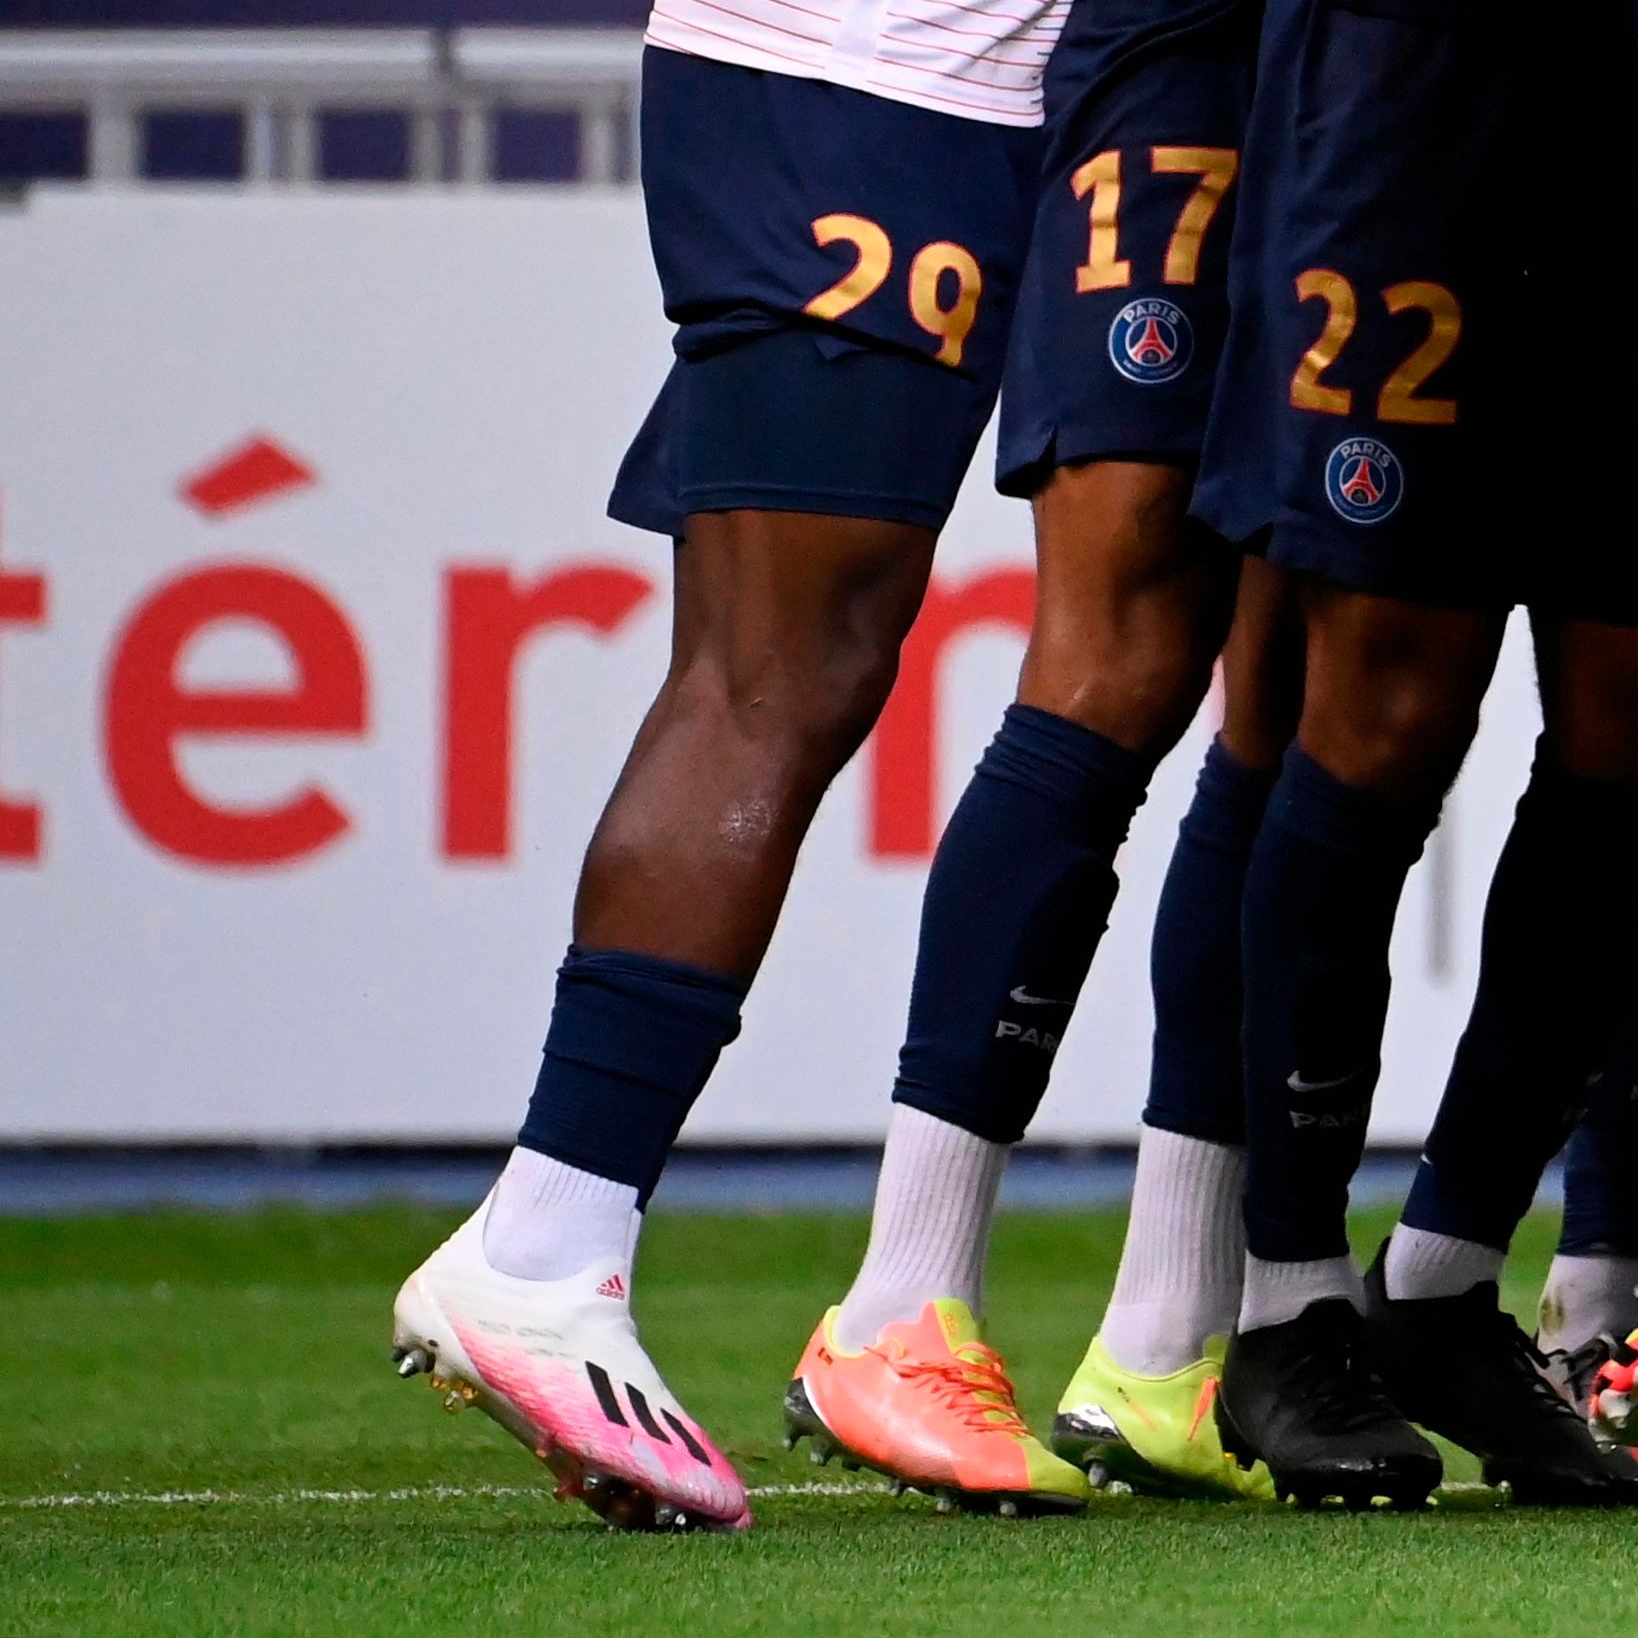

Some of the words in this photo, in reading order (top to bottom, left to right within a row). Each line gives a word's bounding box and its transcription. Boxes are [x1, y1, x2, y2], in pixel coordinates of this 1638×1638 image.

[1069, 144, 1239, 294] 17
[802, 212, 983, 368] 29
[1122, 302, 1181, 325] PARIS
[1289, 267, 1464, 425] 22
[1339, 442, 1391, 468] PARIS
[994, 1019, 1059, 1054] PAR
